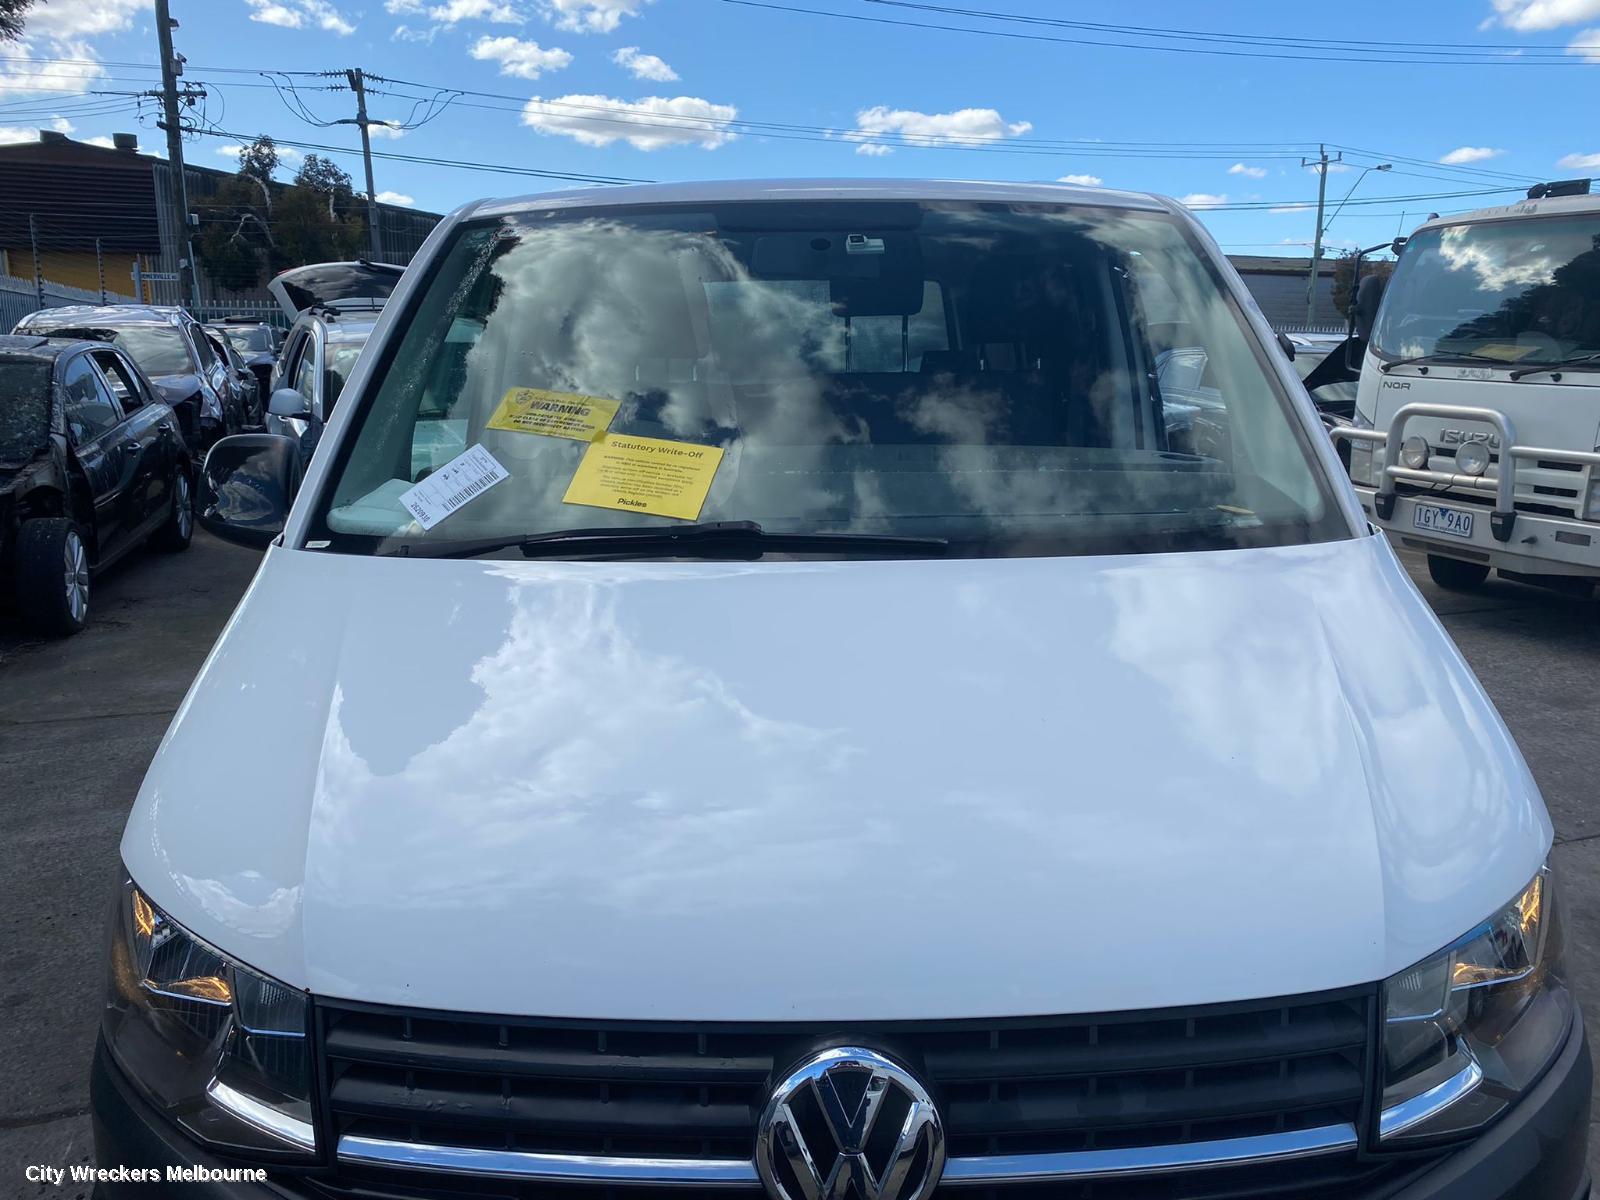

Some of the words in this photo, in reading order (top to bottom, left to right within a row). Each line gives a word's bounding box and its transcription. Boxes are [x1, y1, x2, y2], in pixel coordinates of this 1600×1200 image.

[530, 401, 591, 416] WARNING
[1440, 428, 1500, 448] ISUZU
[610, 440, 656, 454] Statutory
[658, 446, 704, 459] Write-Off
[616, 498, 648, 508] Pickles
